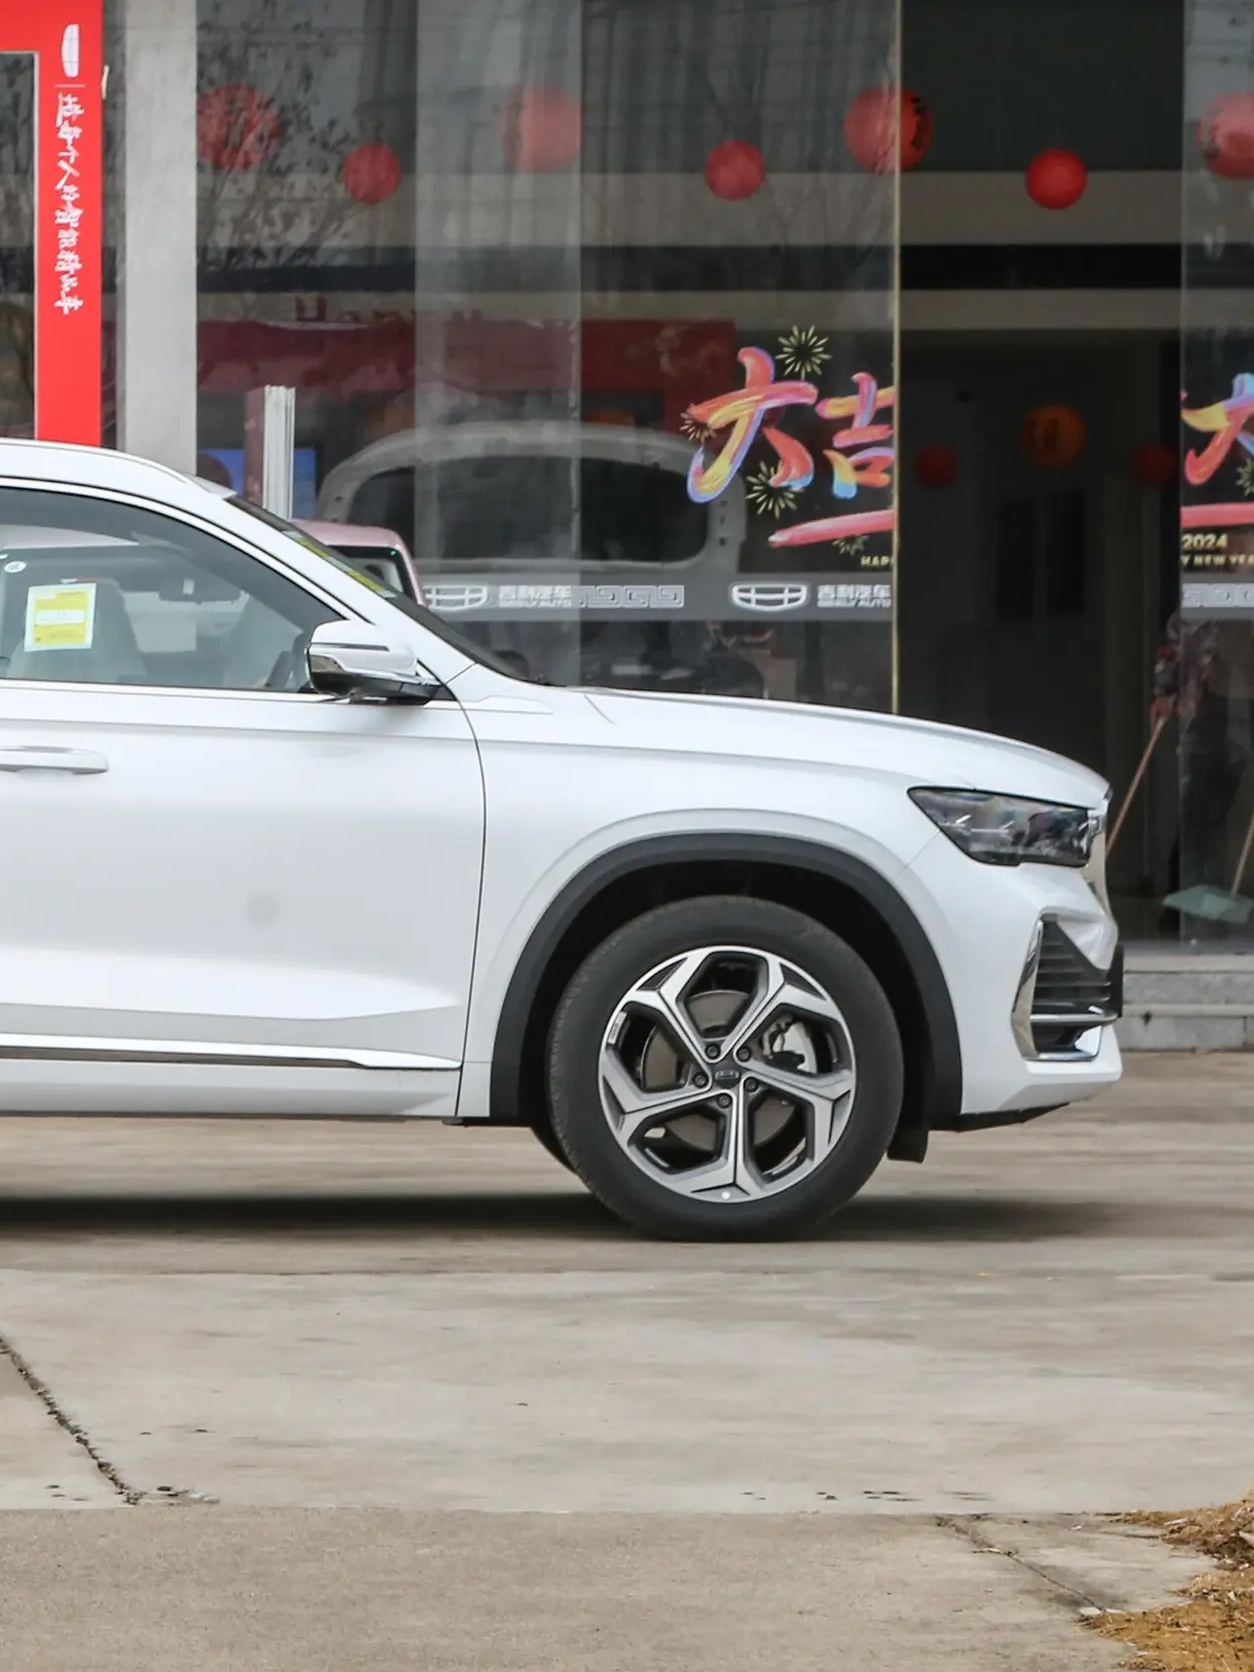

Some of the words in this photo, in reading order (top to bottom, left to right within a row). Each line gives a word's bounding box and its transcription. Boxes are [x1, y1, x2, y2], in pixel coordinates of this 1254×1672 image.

[54, 92, 85, 316] 造每个人的智能精品车
[686, 345, 894, 504] 大吉
[1182, 532, 1229, 550] 2024
[861, 556, 893, 566] HAP
[1193, 554, 1227, 566] NEW
